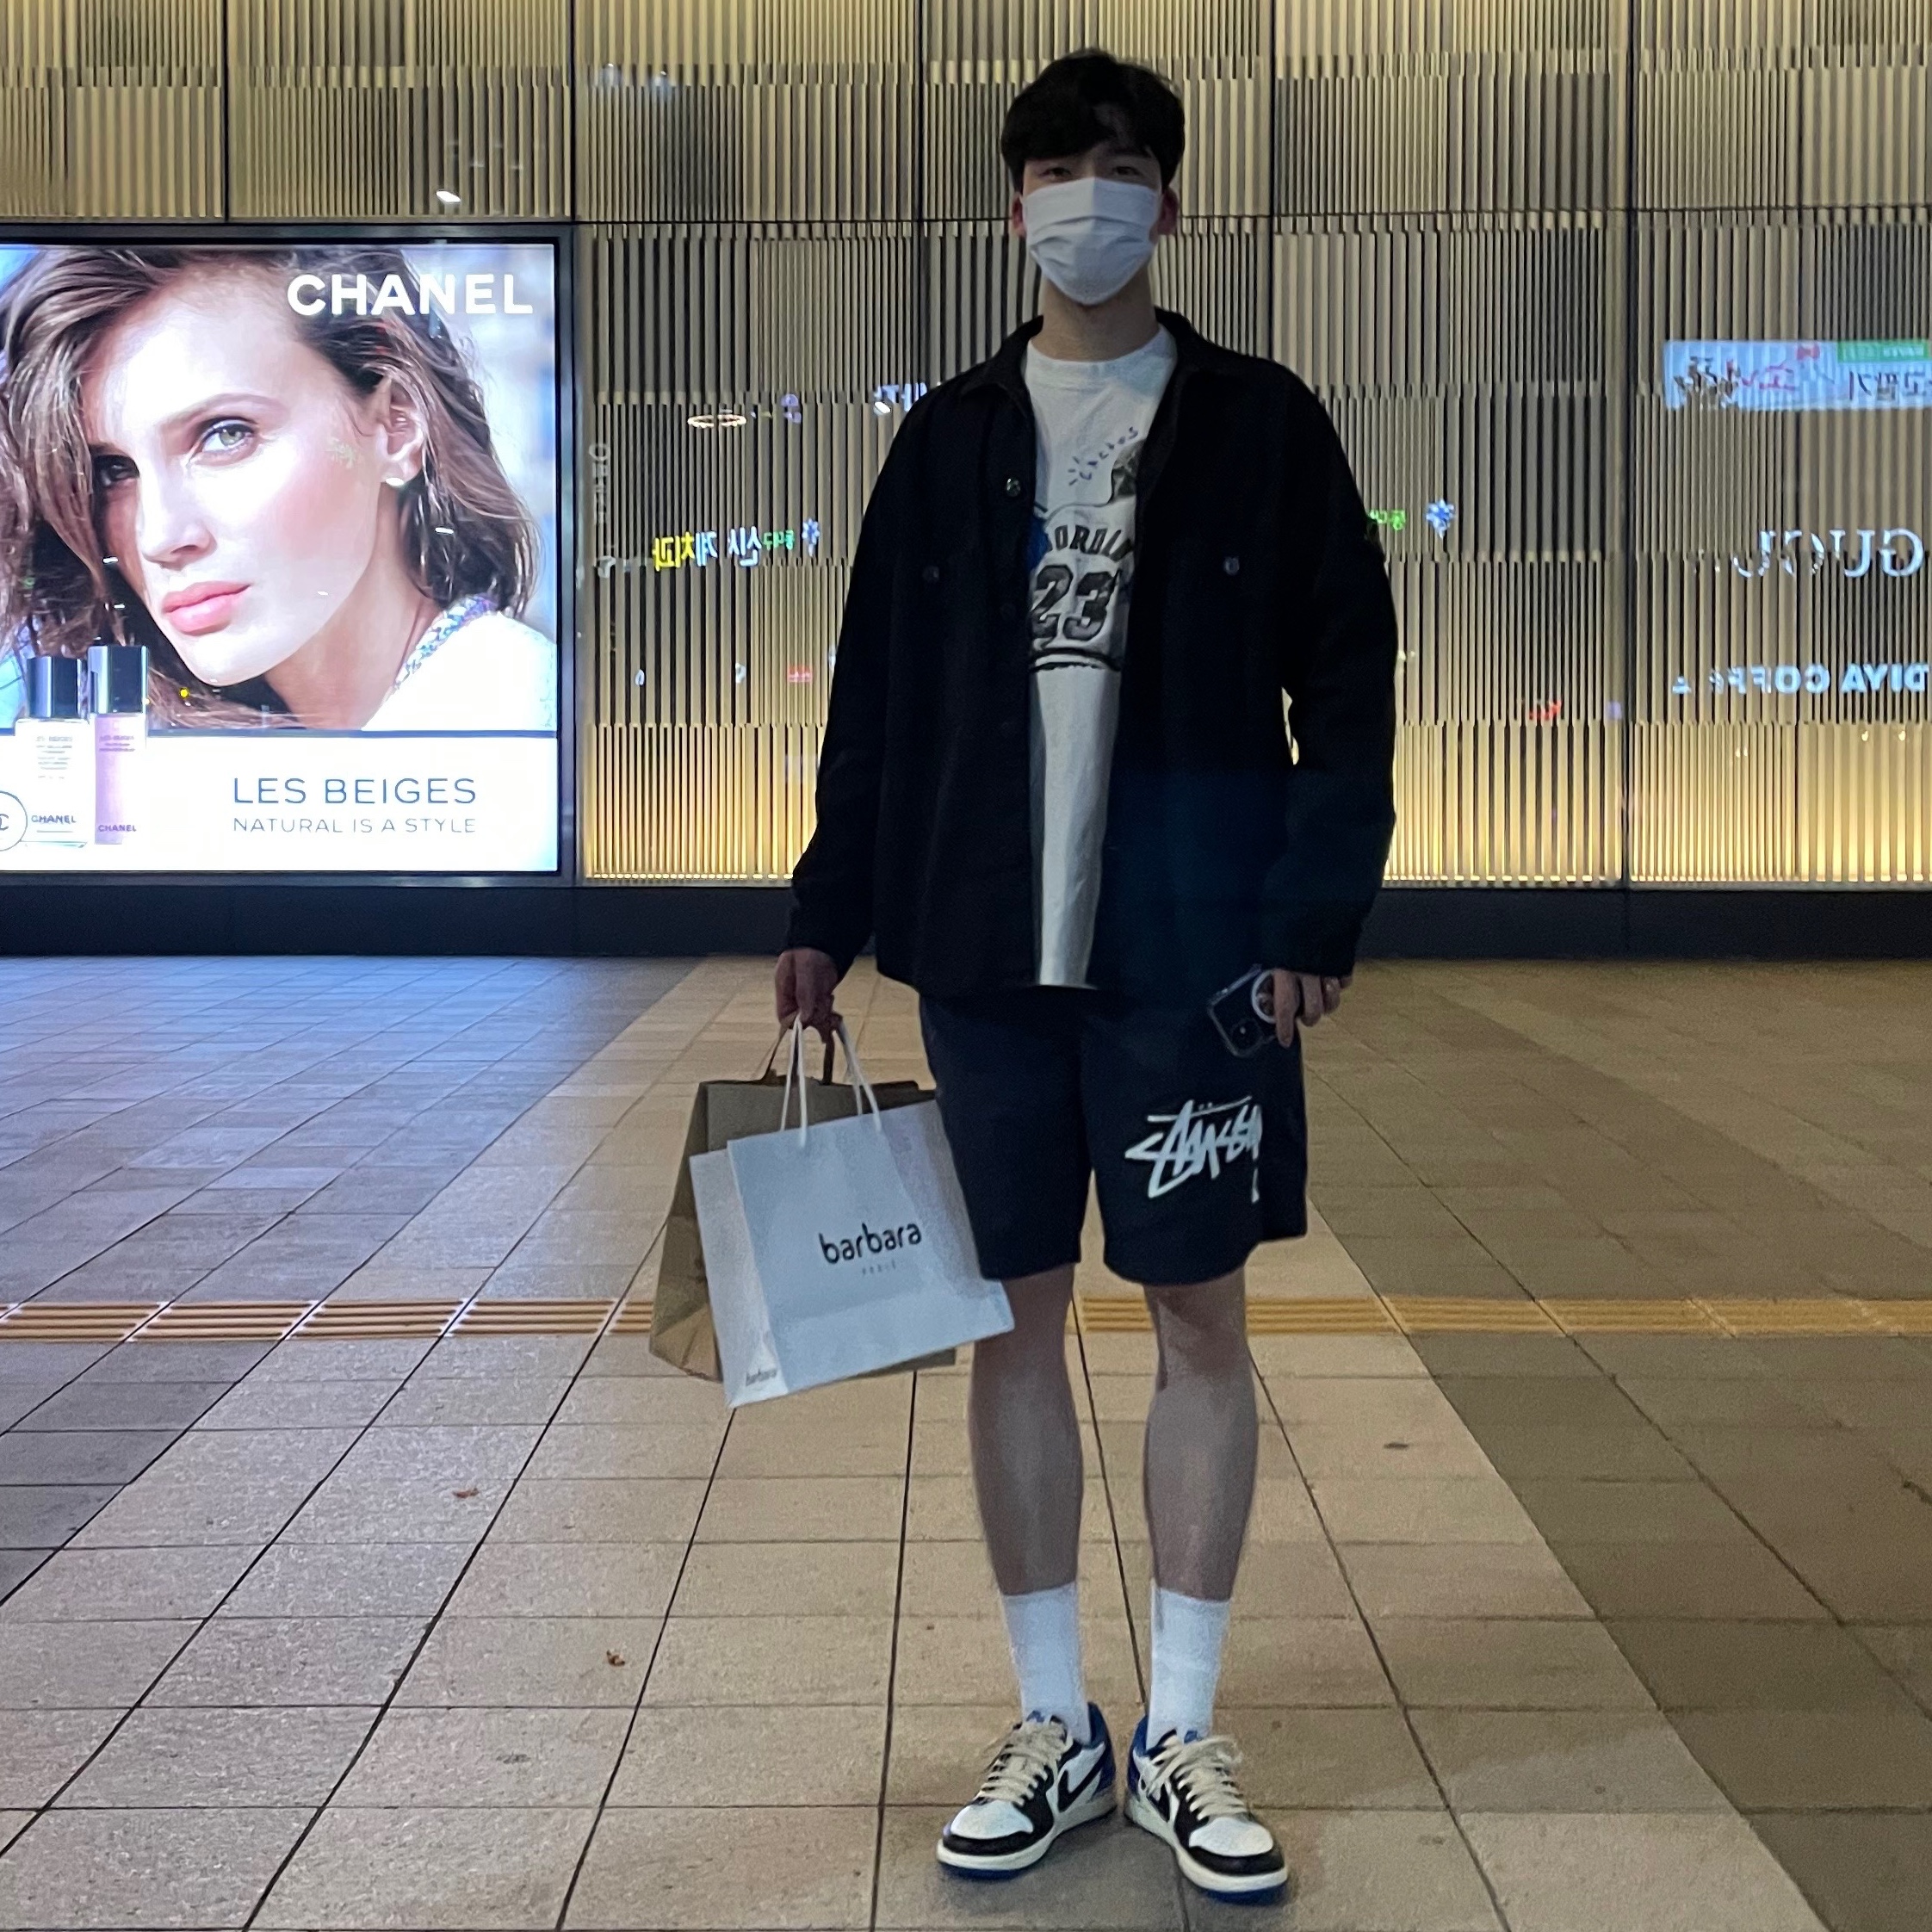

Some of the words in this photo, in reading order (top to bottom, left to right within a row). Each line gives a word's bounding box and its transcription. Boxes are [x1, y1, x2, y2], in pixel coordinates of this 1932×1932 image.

[287, 273, 534, 316] CHANEL
[1046, 524, 1134, 562] ORD
[1030, 563, 1118, 641] 23
[233, 777, 307, 804] LES
[324, 777, 477, 804] BEIGES
[31, 814, 77, 824] CHANEL
[98, 824, 138, 833] CHANEL
[233, 817, 343, 834] NATURAL
[353, 817, 373, 834] IS
[381, 817, 396, 834] A
[405, 817, 476, 834] STYLE
[818, 1221, 922, 1265] barbara
